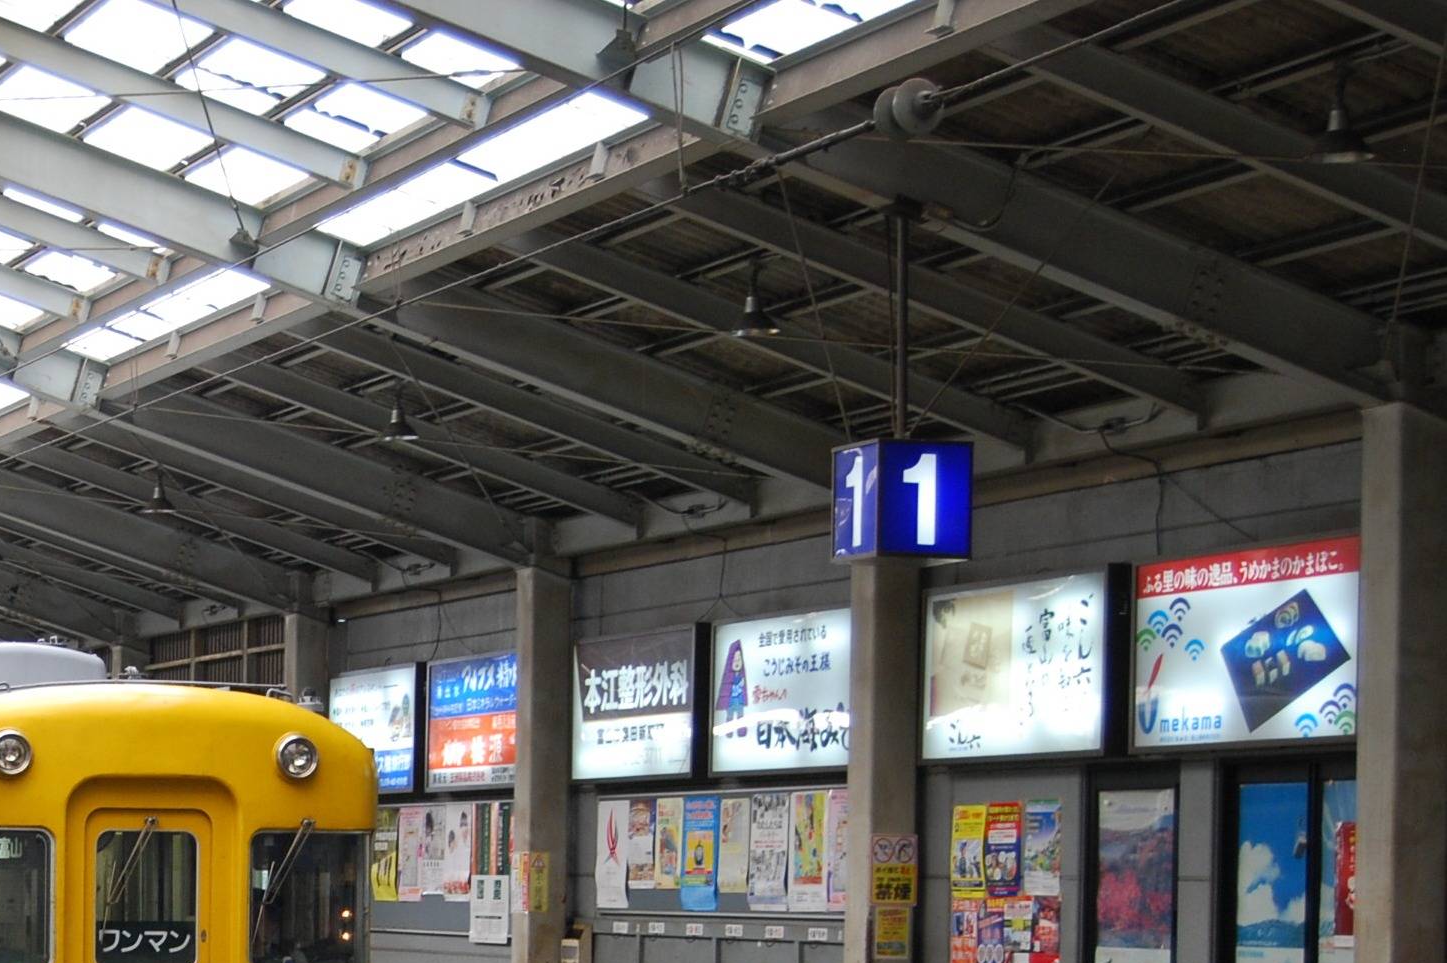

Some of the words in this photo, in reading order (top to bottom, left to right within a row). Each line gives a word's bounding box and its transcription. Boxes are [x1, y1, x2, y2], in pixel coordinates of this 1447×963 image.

[846, 456, 863, 547] 1
[903, 453, 936, 545] 1
[1143, 551, 1344, 593] ふる里の味の逸品、うめかまのかまぼこ。
[584, 659, 689, 714] 本江整形外科
[764, 652, 832, 677] こうじみその王様
[98, 929, 191, 953] ワンマン
